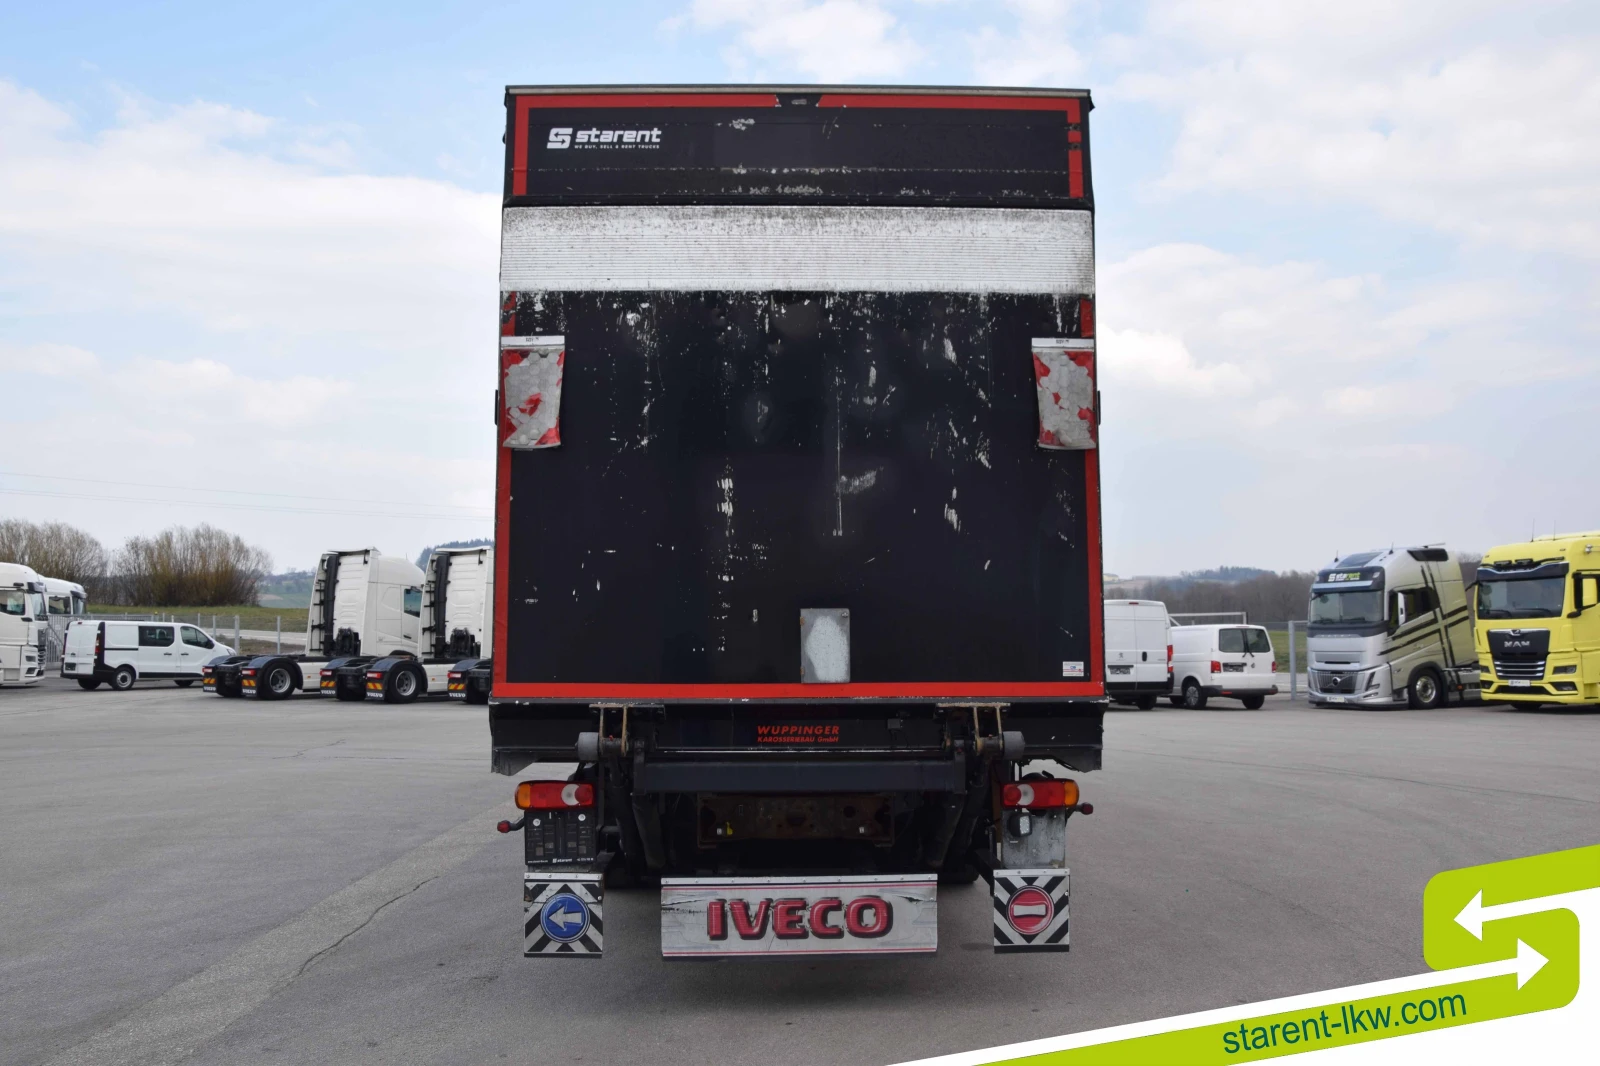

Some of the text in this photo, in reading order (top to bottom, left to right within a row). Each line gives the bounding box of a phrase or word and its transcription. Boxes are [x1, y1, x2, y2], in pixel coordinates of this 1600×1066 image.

[575, 127, 662, 143] starent
[1504, 640, 1530, 648] MAN
[757, 725, 840, 735] WUPPINGER
[707, 895, 893, 941] IVECO
